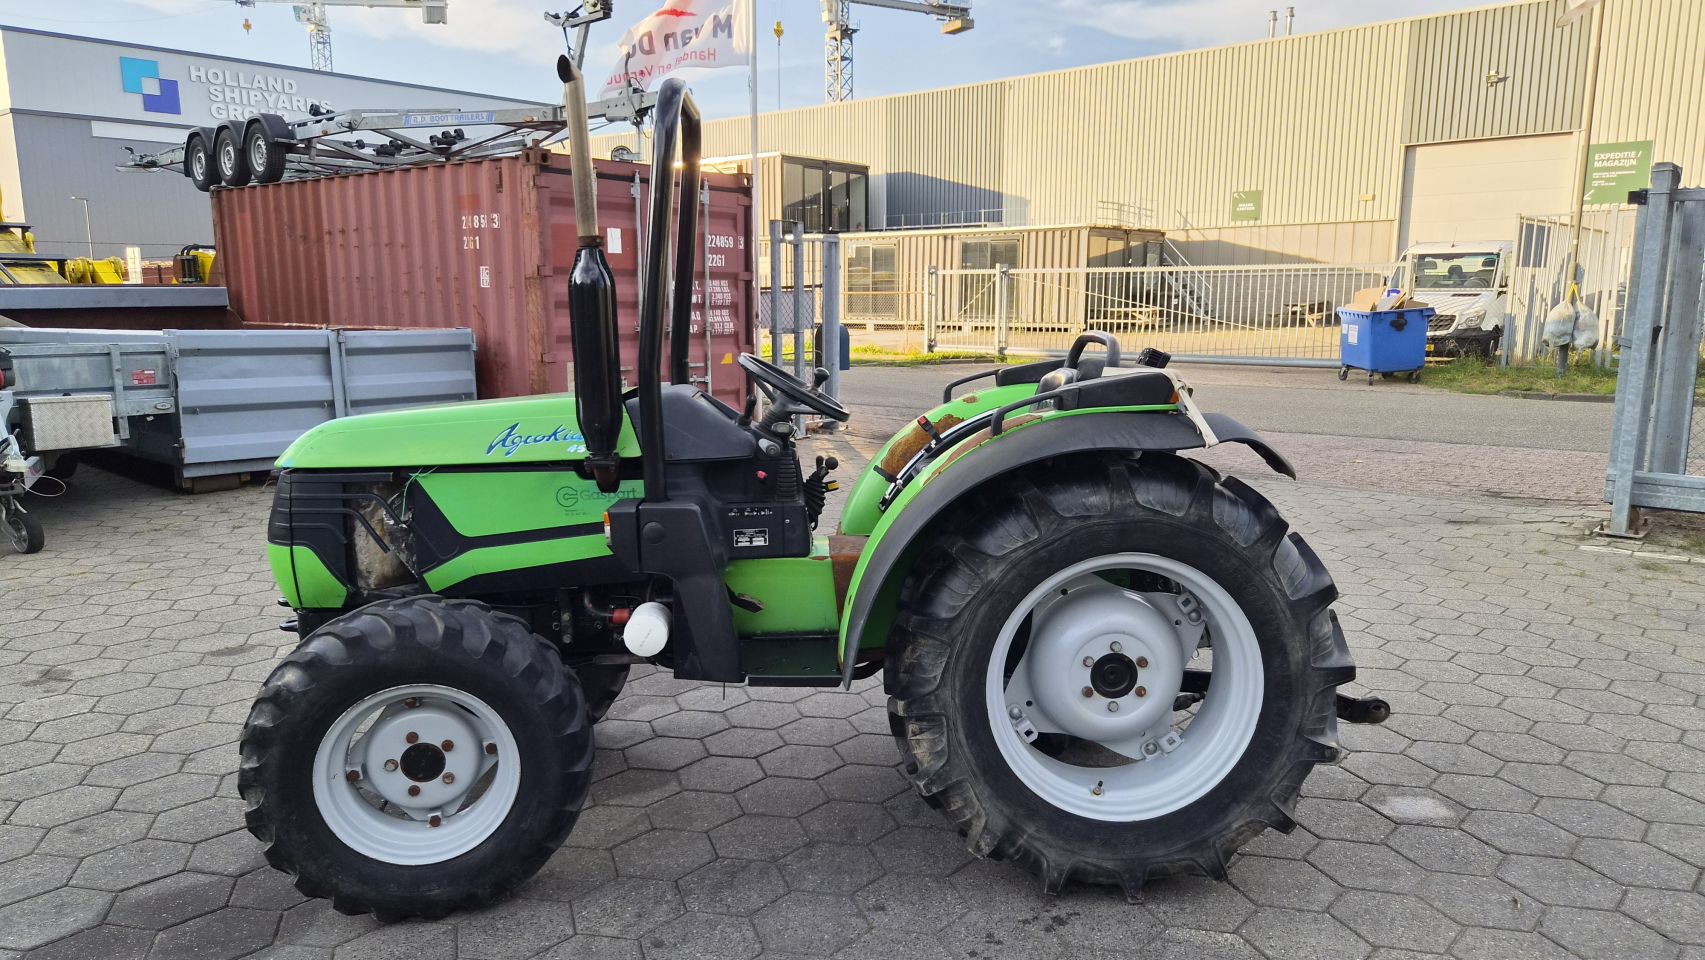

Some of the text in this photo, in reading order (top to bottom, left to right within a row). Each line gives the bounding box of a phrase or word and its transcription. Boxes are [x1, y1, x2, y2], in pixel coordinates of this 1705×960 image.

[189, 65, 298, 95] HOLLAND
[1594, 151, 1637, 160] EXPEDITIE
[1594, 158, 1637, 168] MAGAZIJN
[707, 234, 733, 248] 224859
